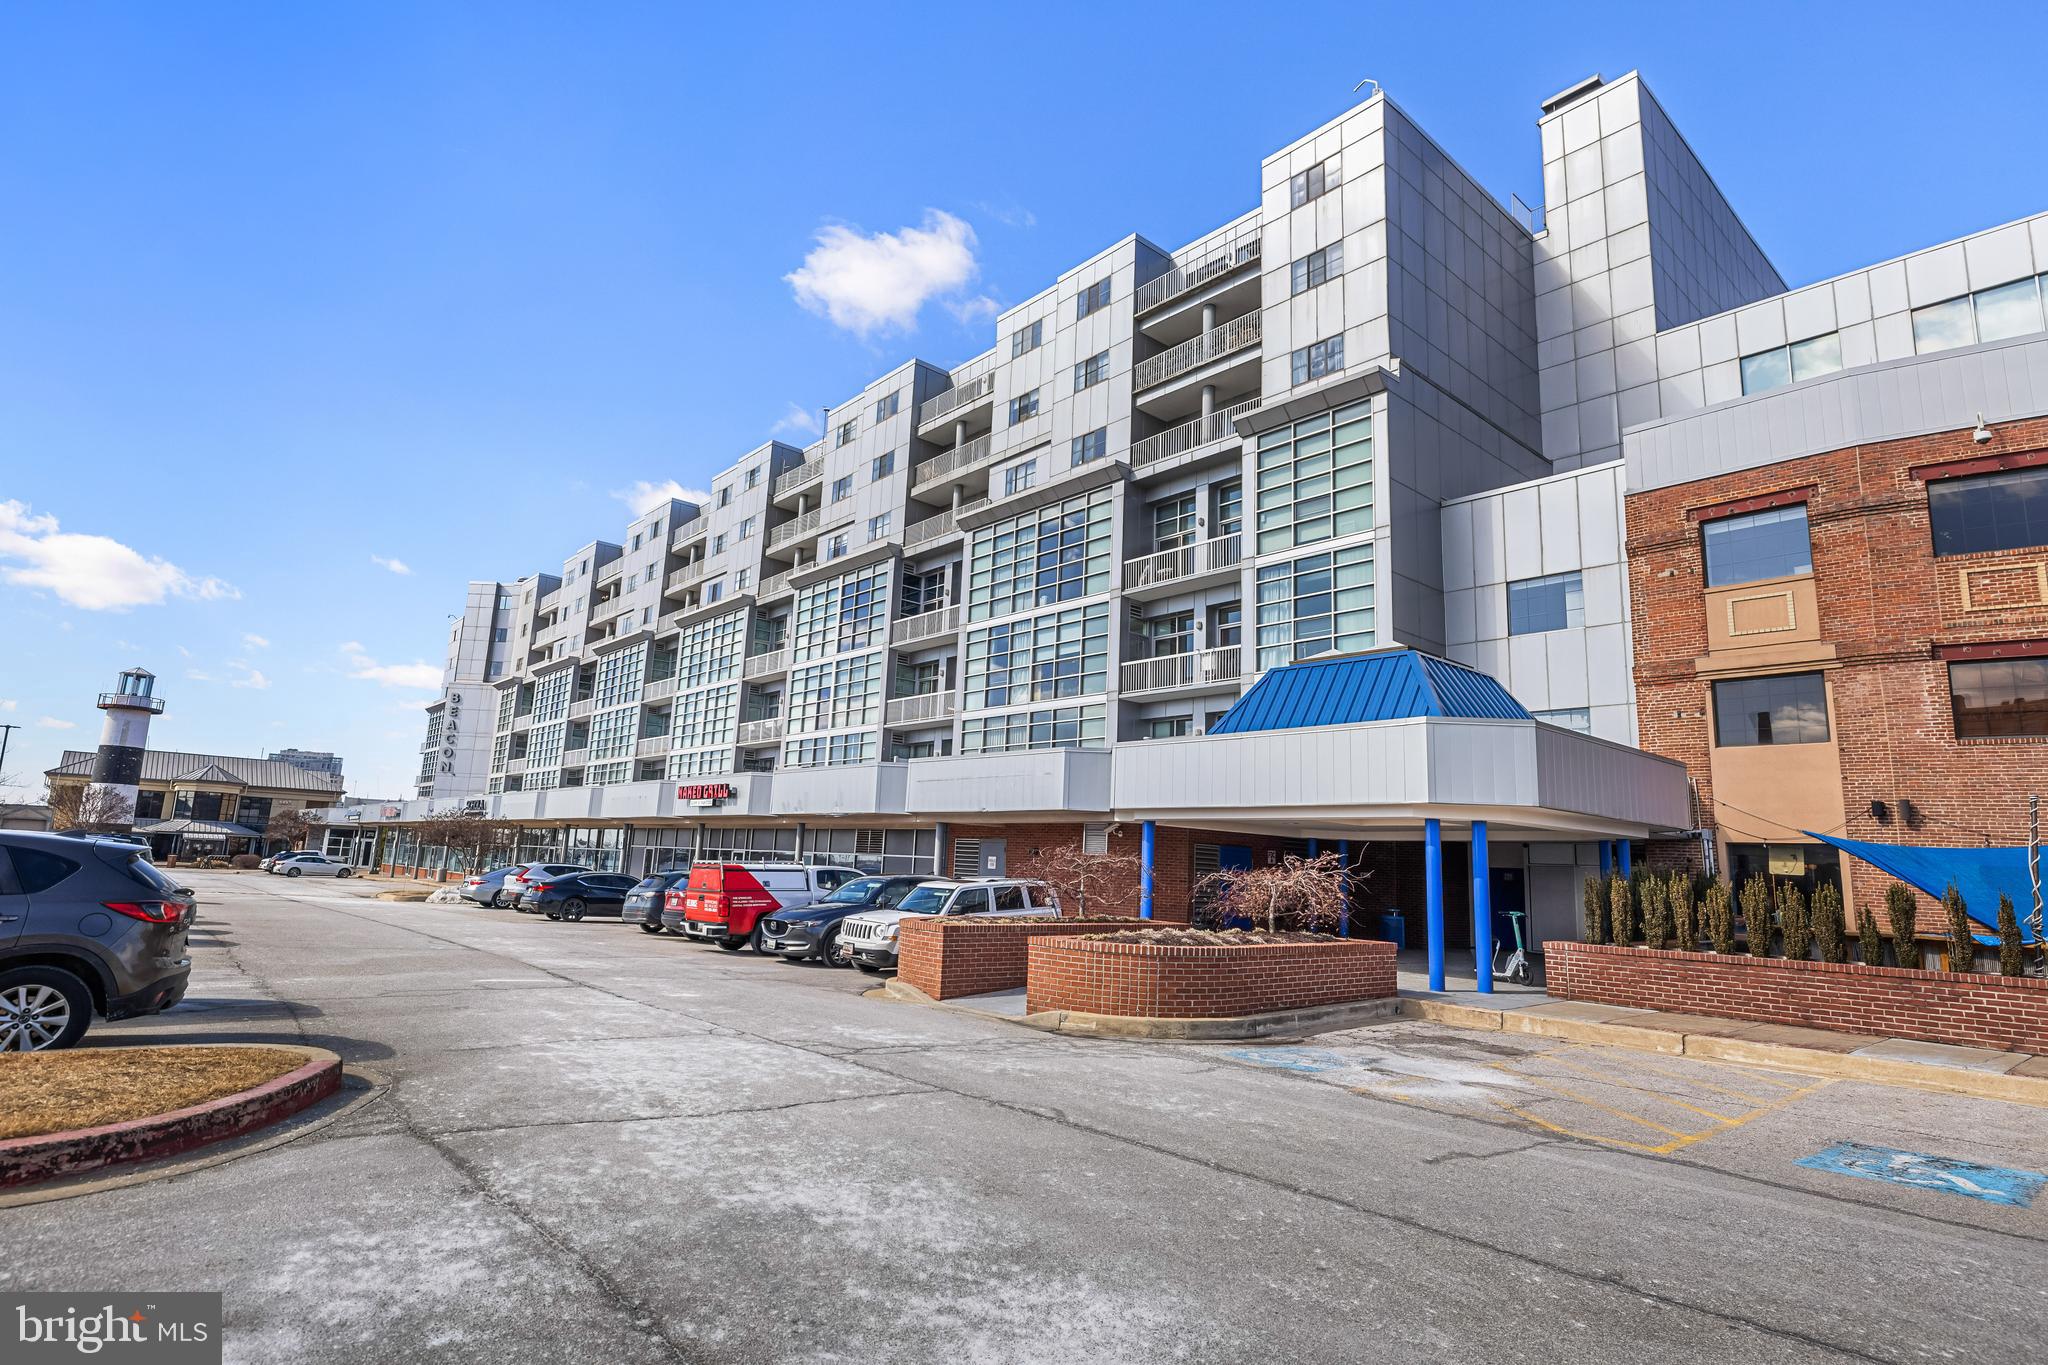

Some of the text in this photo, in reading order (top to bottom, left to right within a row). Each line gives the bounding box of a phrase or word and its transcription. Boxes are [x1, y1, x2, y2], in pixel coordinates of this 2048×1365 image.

[441, 692, 462, 773] BEACON
[678, 784, 729, 799] NAKED GRILL
